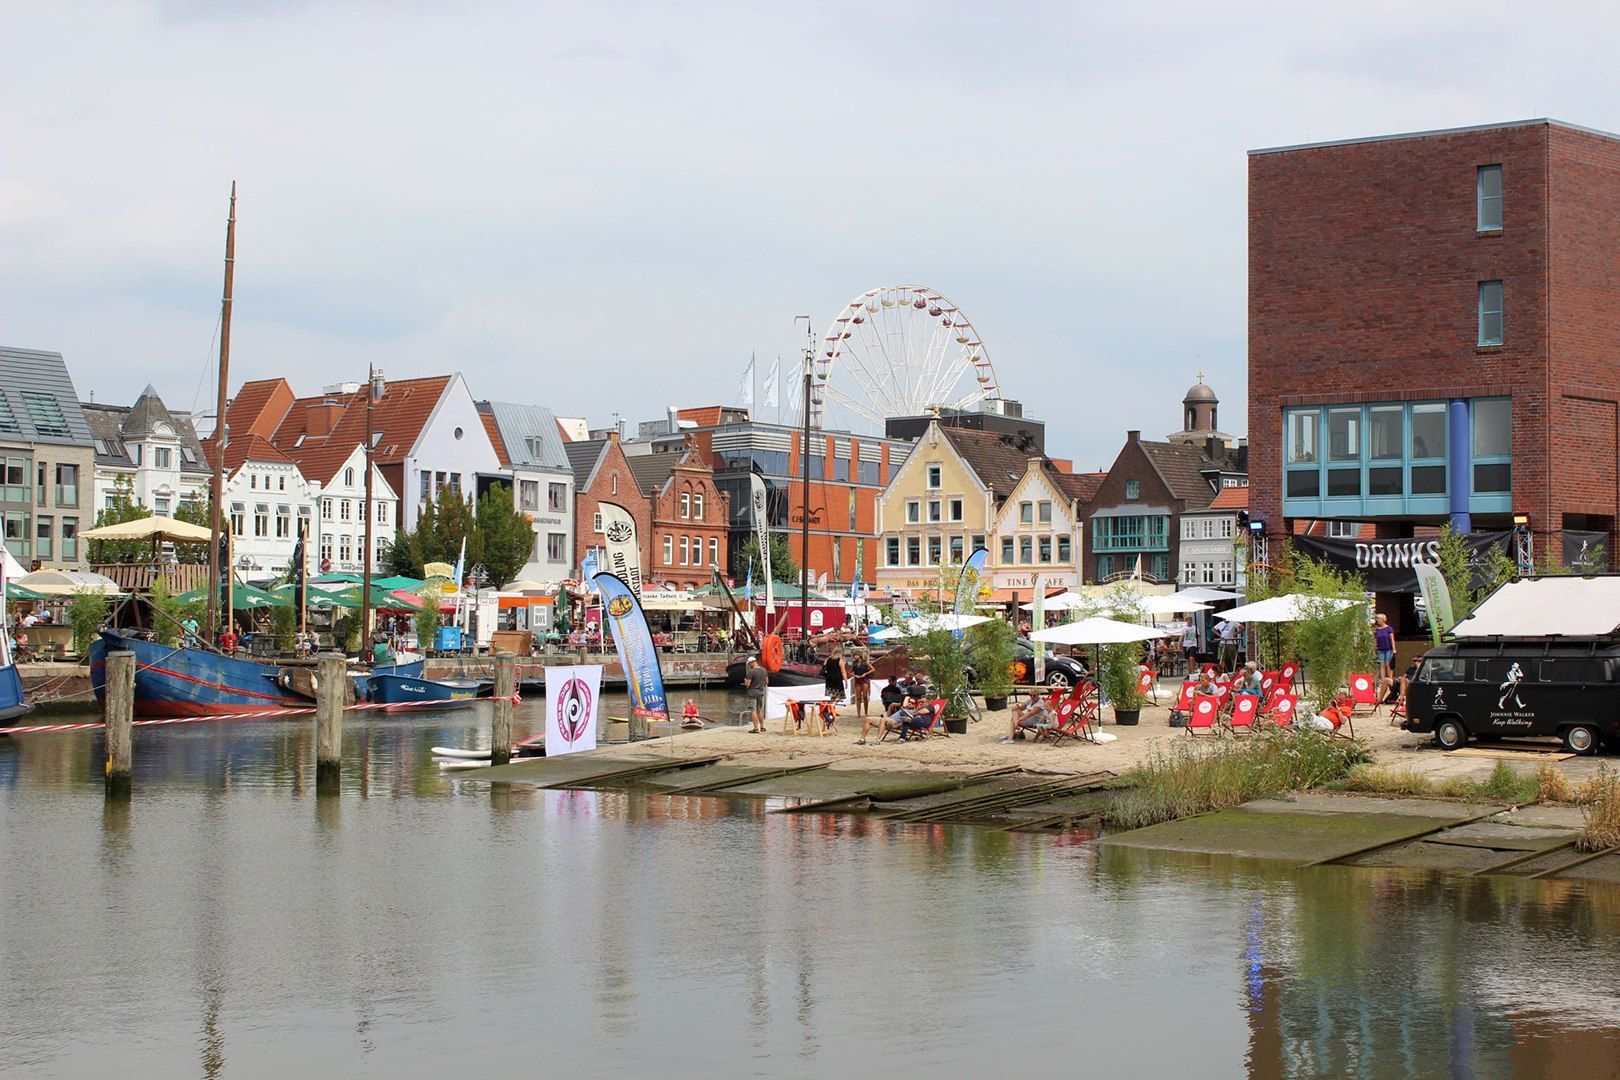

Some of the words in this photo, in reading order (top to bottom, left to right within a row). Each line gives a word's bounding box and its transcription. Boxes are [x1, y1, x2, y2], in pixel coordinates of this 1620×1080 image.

[1355, 541, 1441, 568] DRINKS
[613, 552, 629, 587] DDLING
[1007, 578, 1027, 587] TINE
[1045, 578, 1064, 587] AFE
